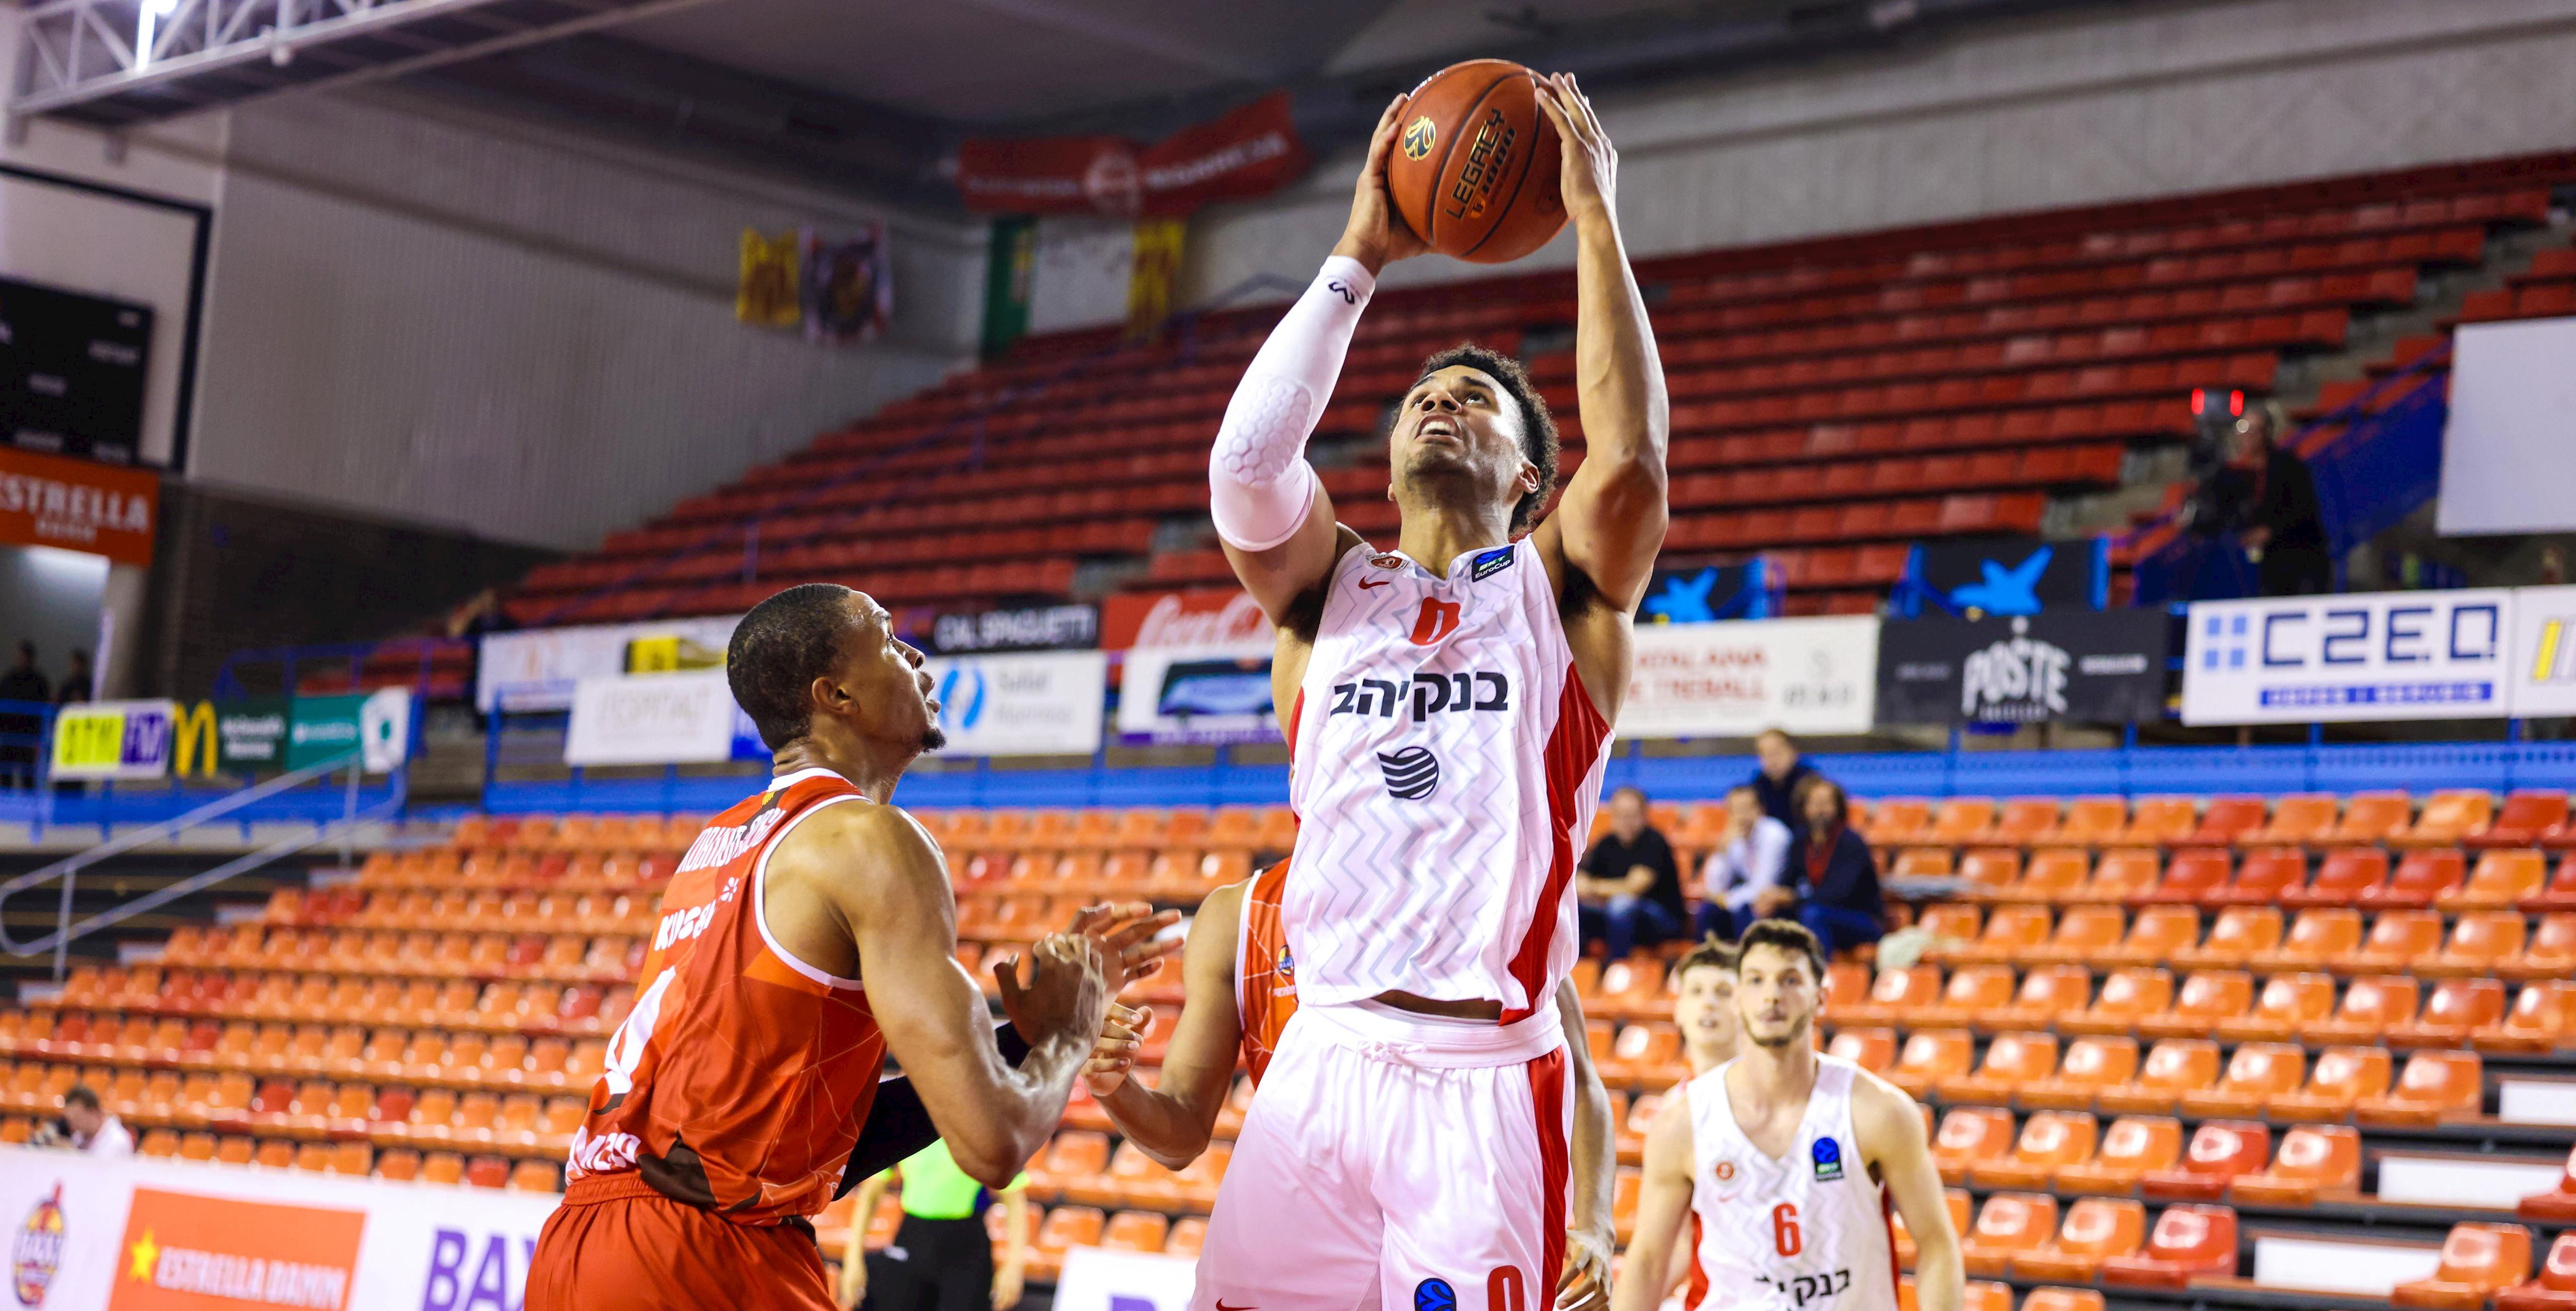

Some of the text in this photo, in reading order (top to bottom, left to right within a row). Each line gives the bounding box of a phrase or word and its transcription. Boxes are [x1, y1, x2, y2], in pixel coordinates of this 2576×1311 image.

[1444, 107, 1507, 220] LEGACY
[1773, 1202, 1802, 1256] 6
[156, 1246, 266, 1302] ESTRELLA
